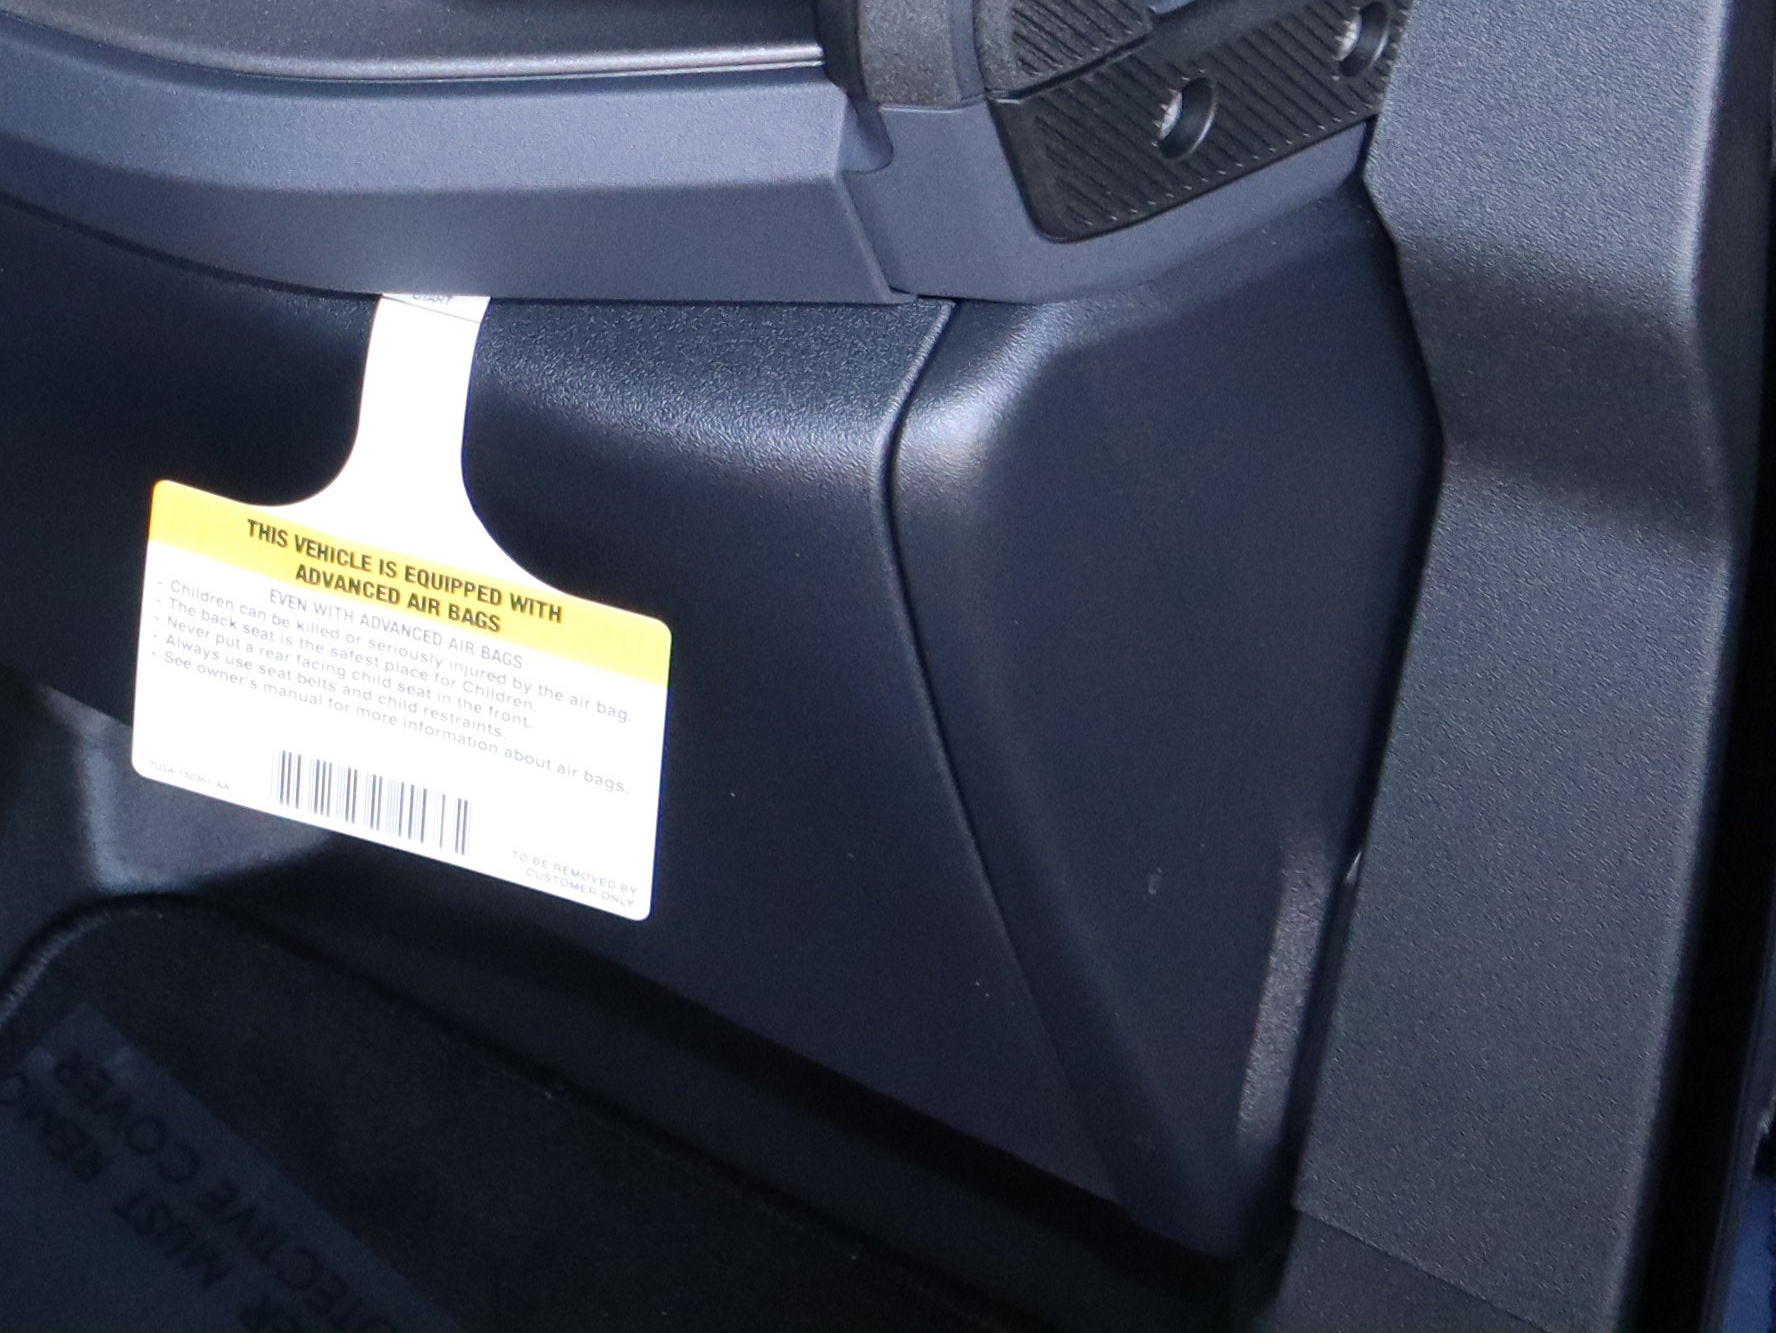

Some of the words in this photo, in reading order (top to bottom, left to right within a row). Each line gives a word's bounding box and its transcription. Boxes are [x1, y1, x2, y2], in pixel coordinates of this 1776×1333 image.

[246, 518, 288, 549] THIS
[294, 534, 372, 574] VEHICLE
[378, 557, 398, 580] IS
[404, 563, 502, 609] EQUIPPED
[508, 592, 562, 625] WITH
[294, 561, 400, 608] ADVANCED
[406, 591, 440, 617] AIR
[448, 601, 500, 634] BAGS
[166, 615, 210, 640] Never
[214, 632, 240, 651] put
[244, 641, 254, 654] a
[258, 644, 288, 663] rear
[296, 653, 346, 680] facing
[350, 667, 392, 691] child
[396, 681, 430, 701] seat
[436, 691, 452, 706] in
[456, 697, 482, 715] the
[168, 597, 196, 617] The
[200, 607, 238, 630] back
[242, 622, 274, 642] seat
[280, 631, 292, 646] is
[298, 636, 324, 655] the
[330, 643, 378, 669] safest
[384, 658, 428, 682] place
[434, 672, 456, 690] for
[170, 579, 234, 611] Children
[238, 602, 266, 621] can
[270, 610, 290, 629] be
[296, 614, 338, 640] killed
[344, 631, 360, 646] or
[368, 636, 442, 670] seriously
[448, 658, 506, 686] injured
[512, 676, 532, 696] by
[536, 684, 564, 702] the
[568, 693, 588, 709] air
[270, 587, 306, 612] EVEN
[312, 599, 354, 624] WITH
[358, 611, 442, 647] ADVANCED
[448, 635, 474, 656] AIR
[480, 644, 522, 670] BAGS
[162, 649, 192, 671] See
[262, 678, 322, 707] manual
[328, 696, 348, 714] for
[356, 706, 396, 727] more
[402, 716, 498, 756] information
[504, 746, 550, 771] about
[556, 760, 578, 778] air
[164, 633, 220, 662] Always
[224, 654, 252, 672] use
[258, 661, 290, 682] seat
[342, 683, 372, 702] and
[378, 691, 418, 715] child
[510, 849, 528, 863] TO
[532, 856, 548, 869] BE
[552, 861, 616, 890] REMOVED
[620, 882, 636, 896] BY
[526, 866, 596, 896] CUSTOMER
[600, 889, 634, 908] ONLY
